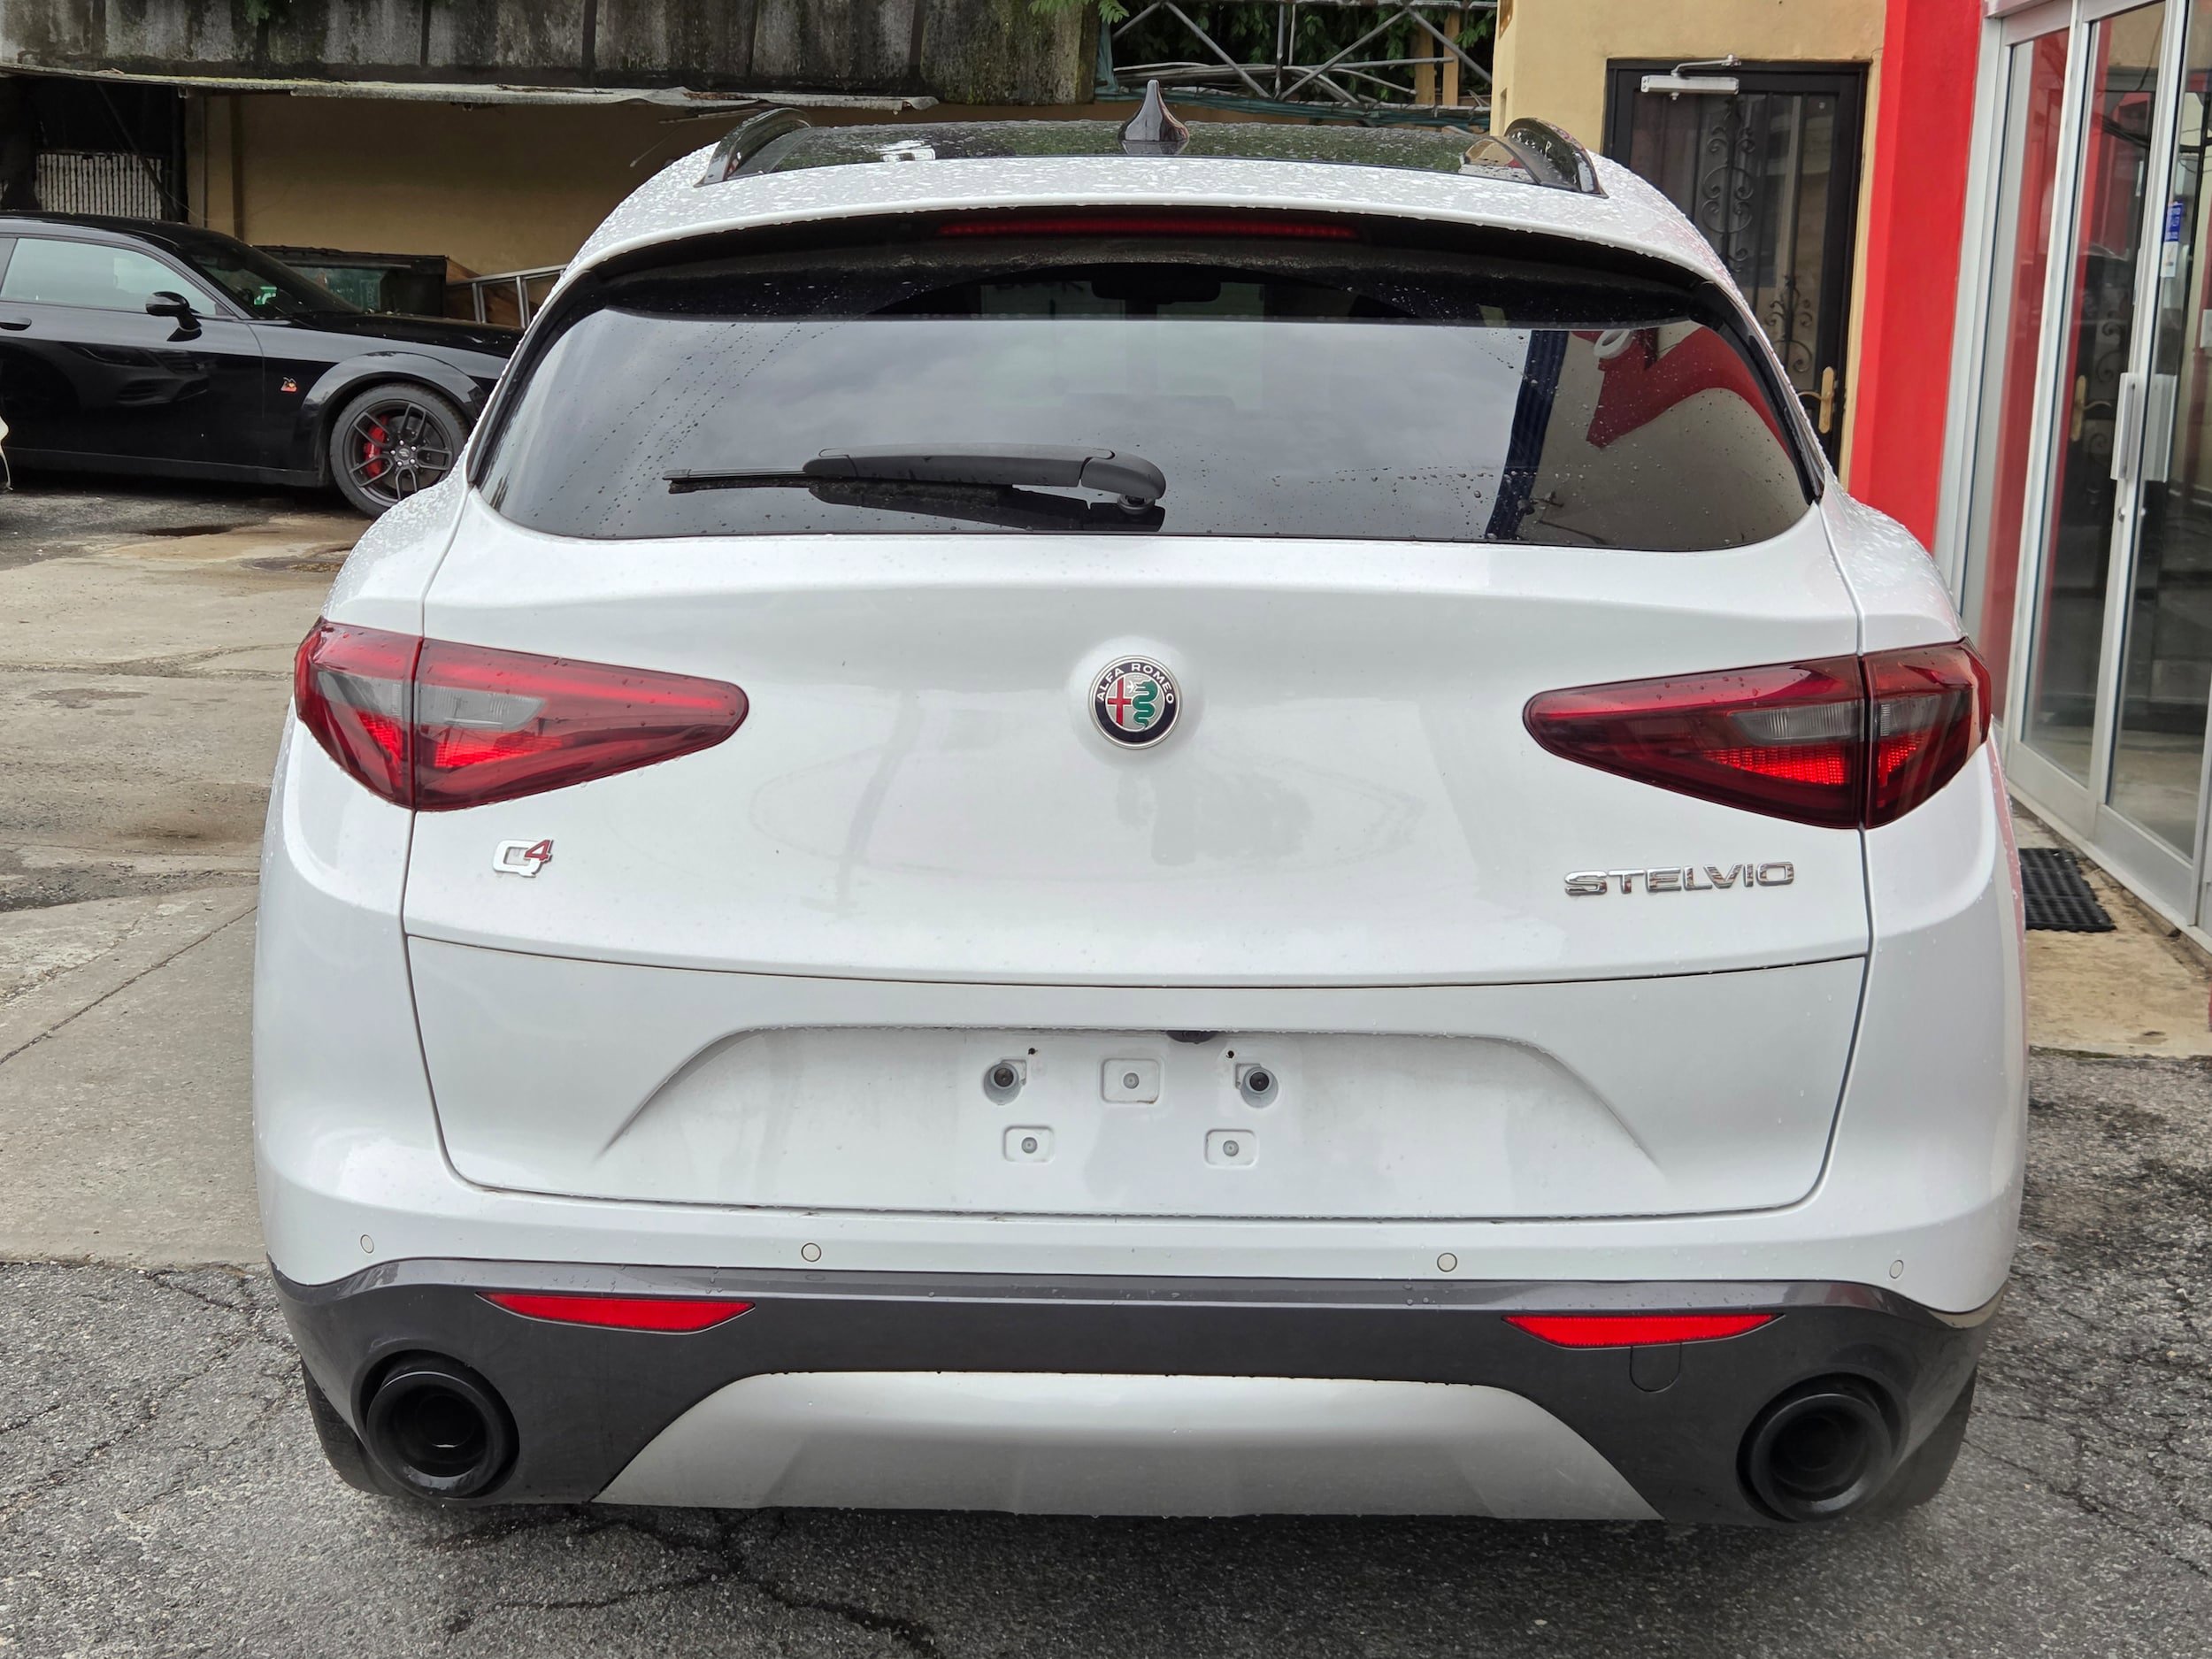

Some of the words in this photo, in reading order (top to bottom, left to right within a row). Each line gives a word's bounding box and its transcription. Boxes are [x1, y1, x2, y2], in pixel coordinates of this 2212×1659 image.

[1097, 667, 1125, 702] ALFA
[1132, 663, 1175, 704] ROMEO
[493, 839, 553, 878] Q4
[1563, 861, 1795, 895] STELVIO
